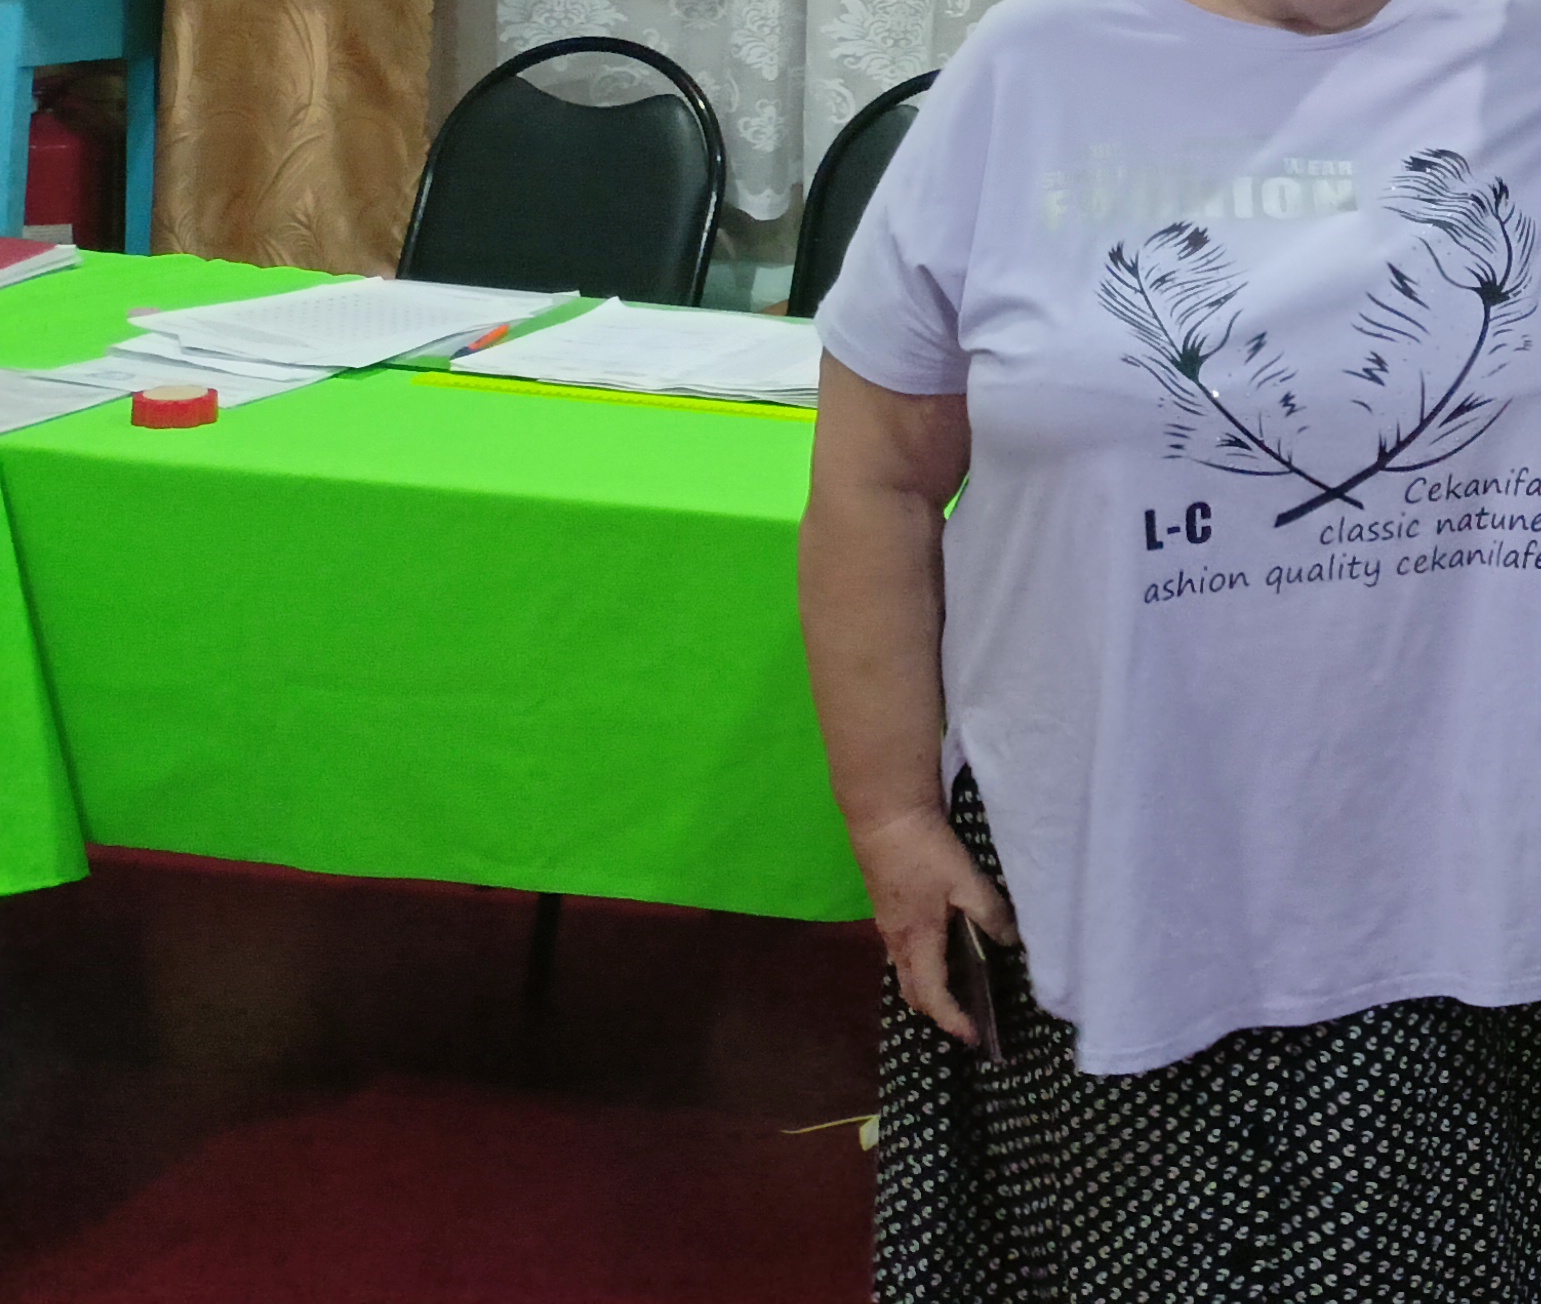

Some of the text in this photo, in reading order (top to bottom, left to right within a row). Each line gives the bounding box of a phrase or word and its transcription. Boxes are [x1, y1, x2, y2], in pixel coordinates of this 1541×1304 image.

[1144, 501, 1212, 551] L-C
[1320, 512, 1420, 546] classic
[1144, 565, 1250, 604] ashion
[1266, 552, 1381, 595] quality
